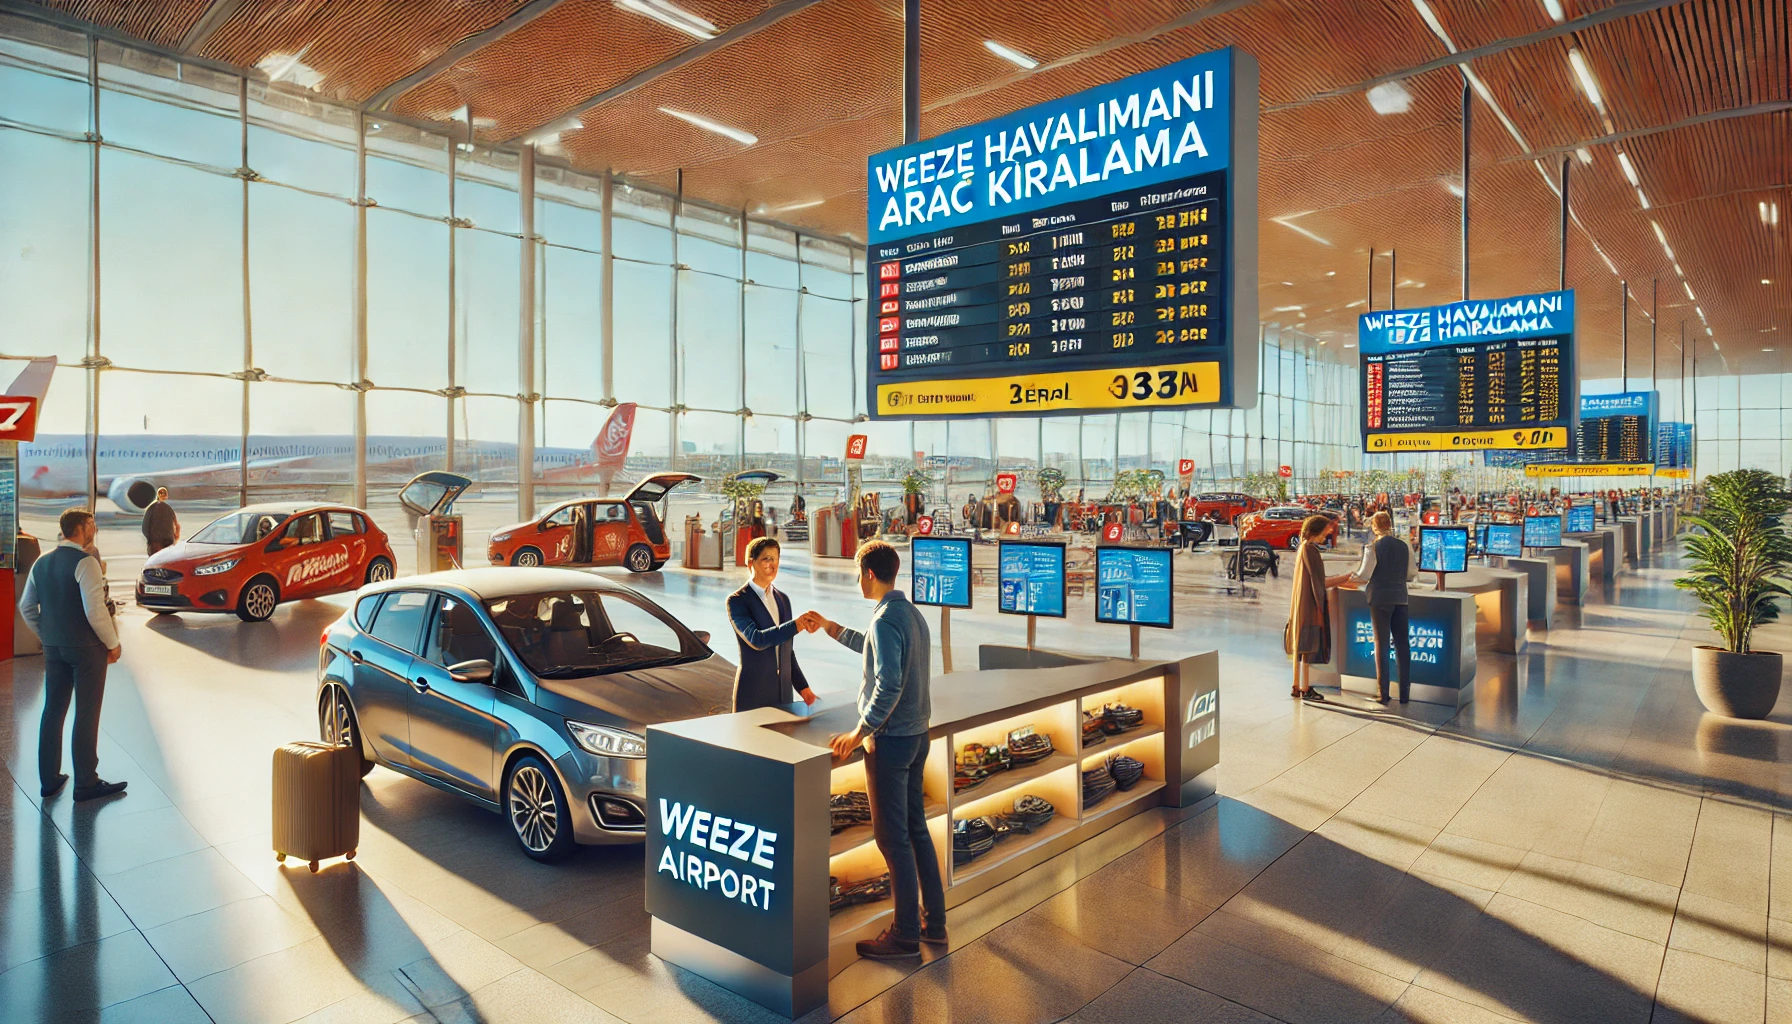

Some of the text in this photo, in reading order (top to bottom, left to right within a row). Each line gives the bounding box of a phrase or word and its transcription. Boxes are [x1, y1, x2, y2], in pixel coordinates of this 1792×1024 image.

[876, 70, 1214, 192] WEEZE HAVALIMANI
[659, 797, 778, 870] WEEZE
[658, 845, 776, 911] AIRPORT
